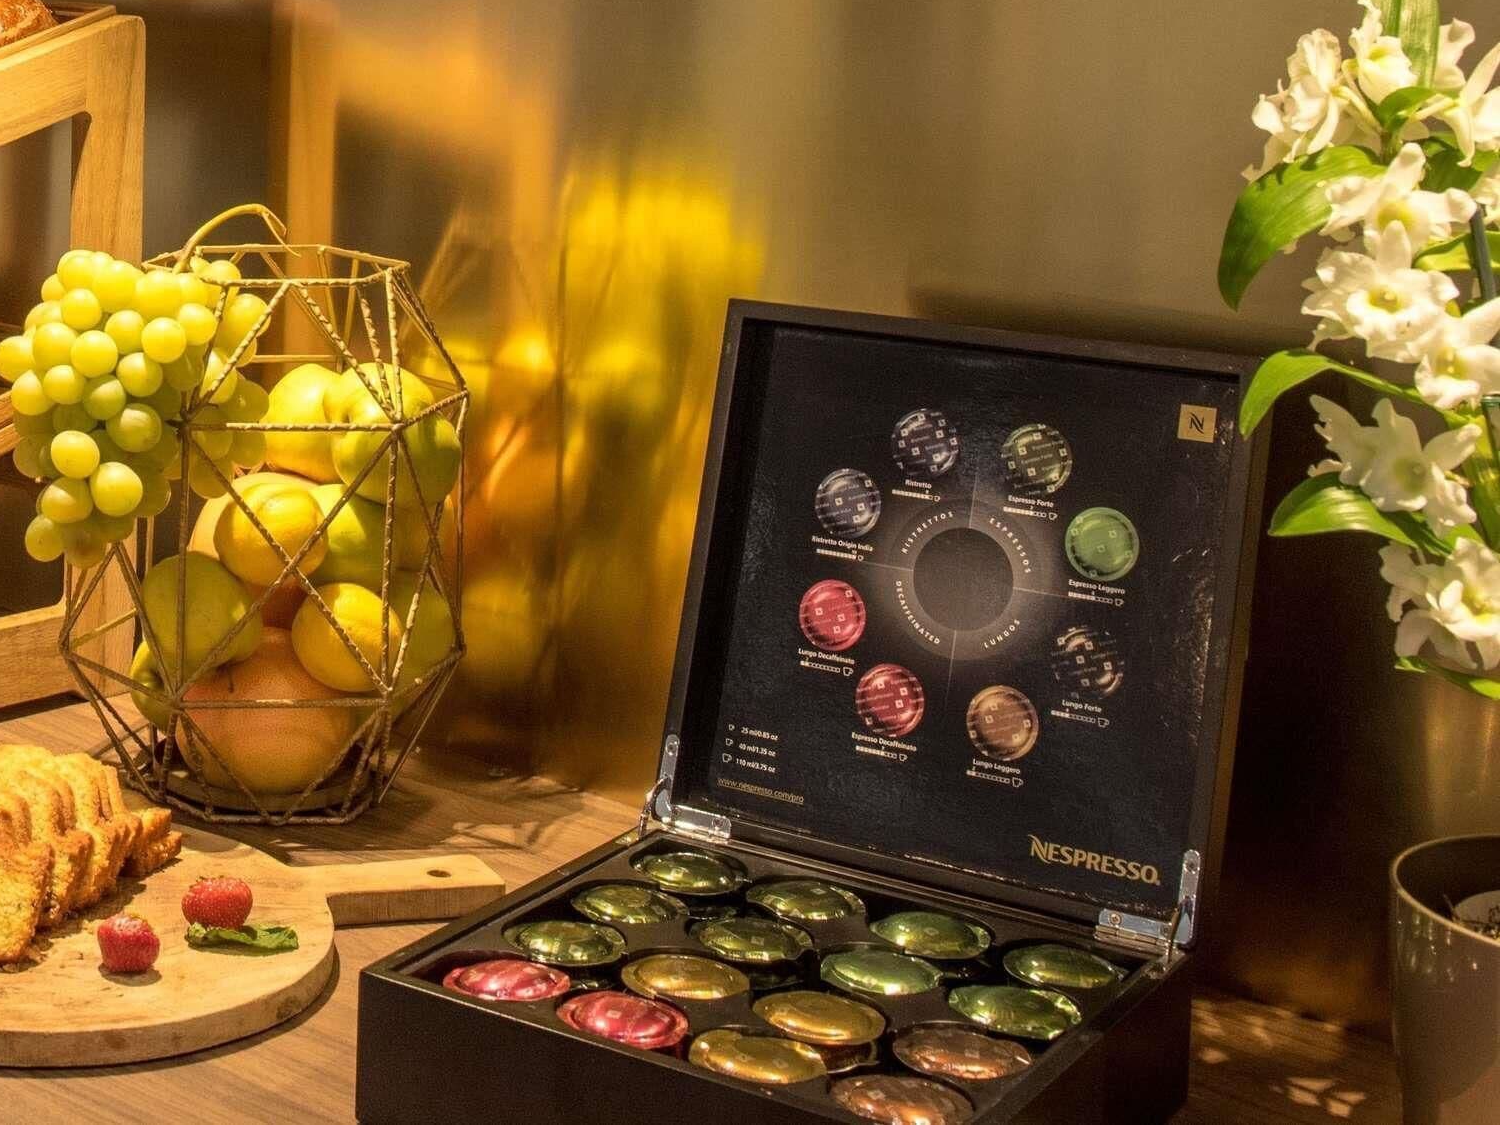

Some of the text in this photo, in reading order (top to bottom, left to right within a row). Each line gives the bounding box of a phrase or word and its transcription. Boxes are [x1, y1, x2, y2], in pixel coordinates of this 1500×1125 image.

[905, 479, 932, 489] Ristretto
[1008, 495, 1054, 508] Espresso Forte
[901, 511, 954, 555] RISTRETTOS
[838, 540, 857, 549] Origin
[858, 543, 874, 552] India
[989, 517, 1032, 574] ESPRESSOS
[1068, 579, 1097, 590] Espresso
[1098, 584, 1126, 594] Leggero
[895, 580, 941, 645] DECAFFEINATED
[983, 618, 1021, 649] LUNGOS
[798, 648, 855, 664] Lungo Decaffeinato
[1061, 699, 1102, 713] Lungo Forte
[851, 731, 917, 752] Espresso Decaffeinato
[735, 758, 746, 767] 110
[972, 758, 1021, 774] Lungo Leggero
[717, 778, 804, 804] www.nespresso.com/pro
[1028, 834, 1161, 886] NESPRESSO
